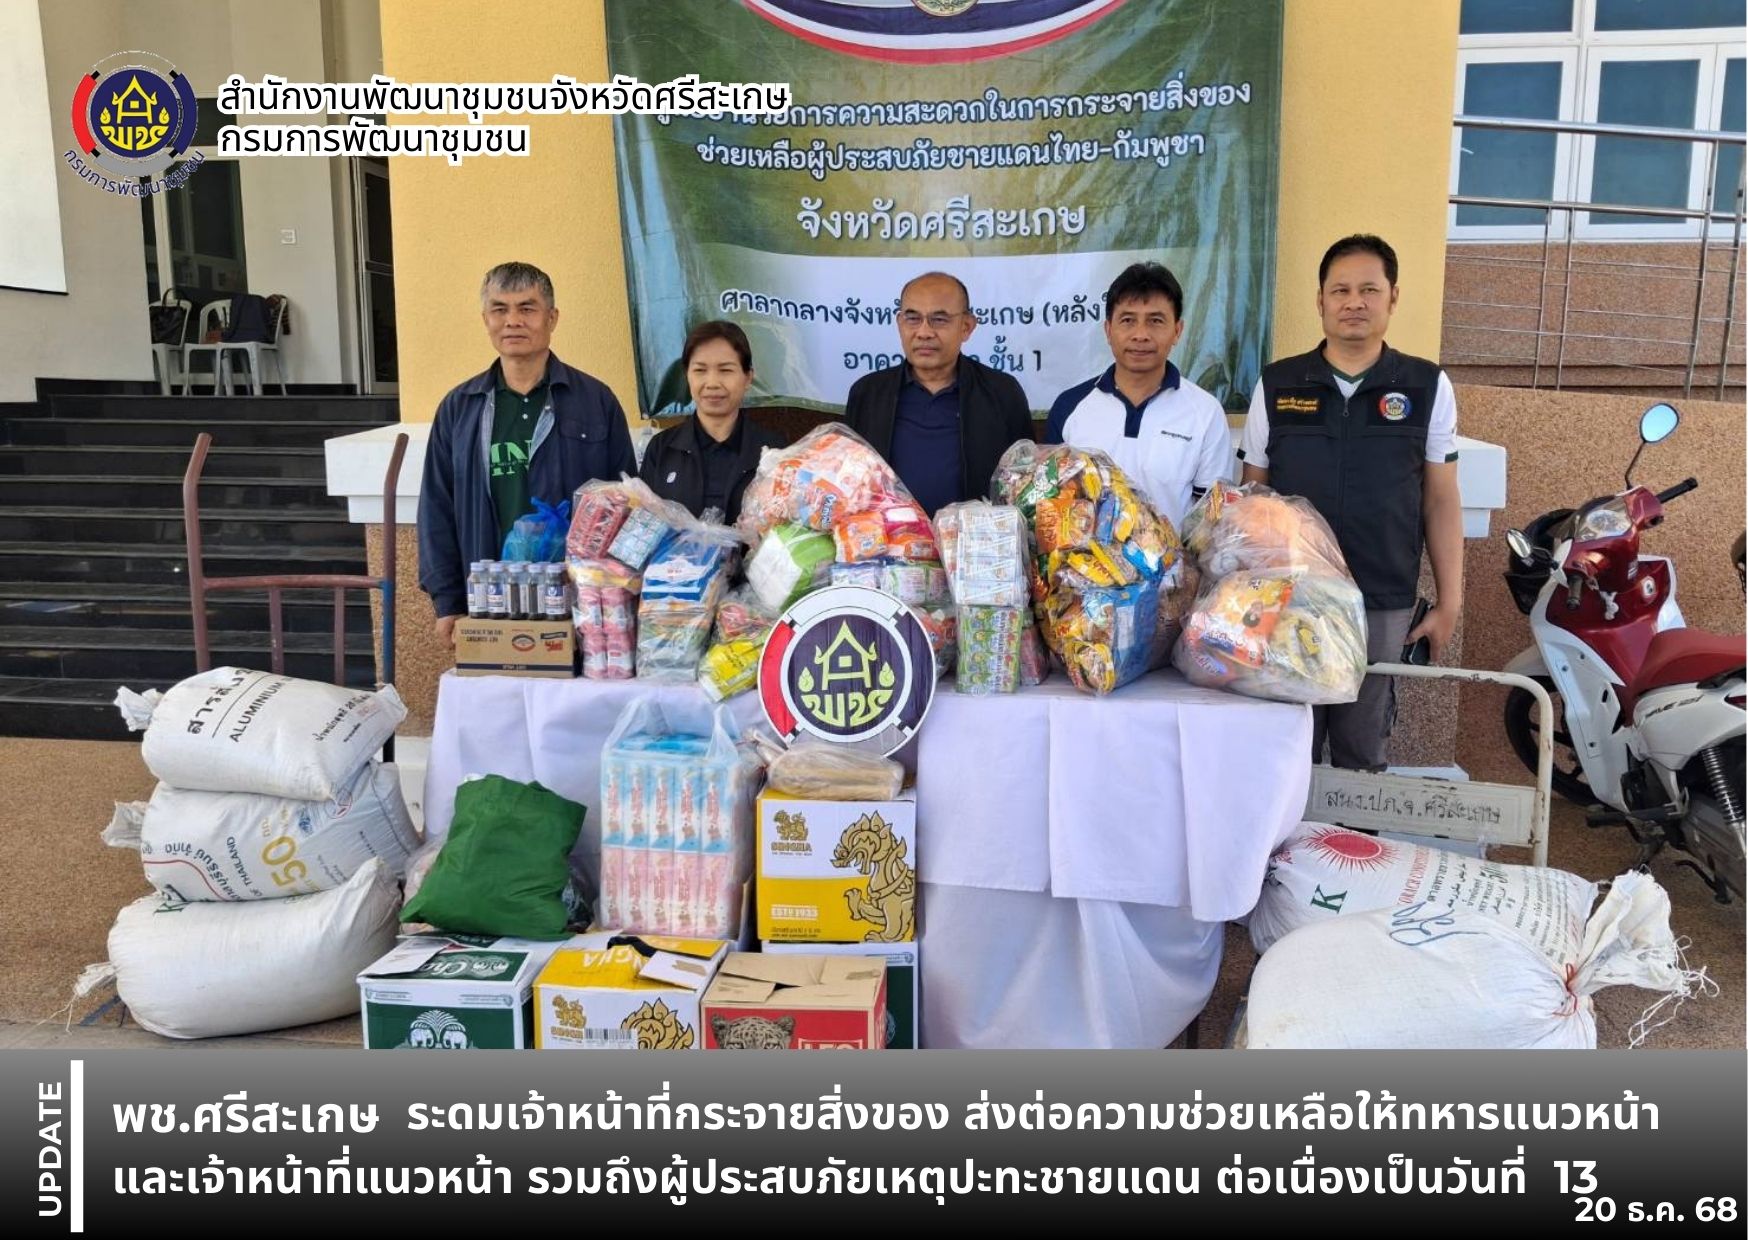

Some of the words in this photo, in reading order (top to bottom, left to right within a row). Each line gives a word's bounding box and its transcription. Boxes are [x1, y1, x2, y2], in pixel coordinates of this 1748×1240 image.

[696, 129, 1206, 180] ช่วยเหลือผู้ประสบภัยชายแดนไทย-กัมพูชา
[796, 196, 1087, 241] จังหวัดศรีสะเกษ
[989, 336, 1024, 372] ชั้น
[1033, 350, 1042, 371] 1
[229, 681, 283, 743] ALUMINIUM
[226, 836, 252, 889] THAILAND
[261, 836, 307, 888] 50
[1310, 884, 1348, 914] K
